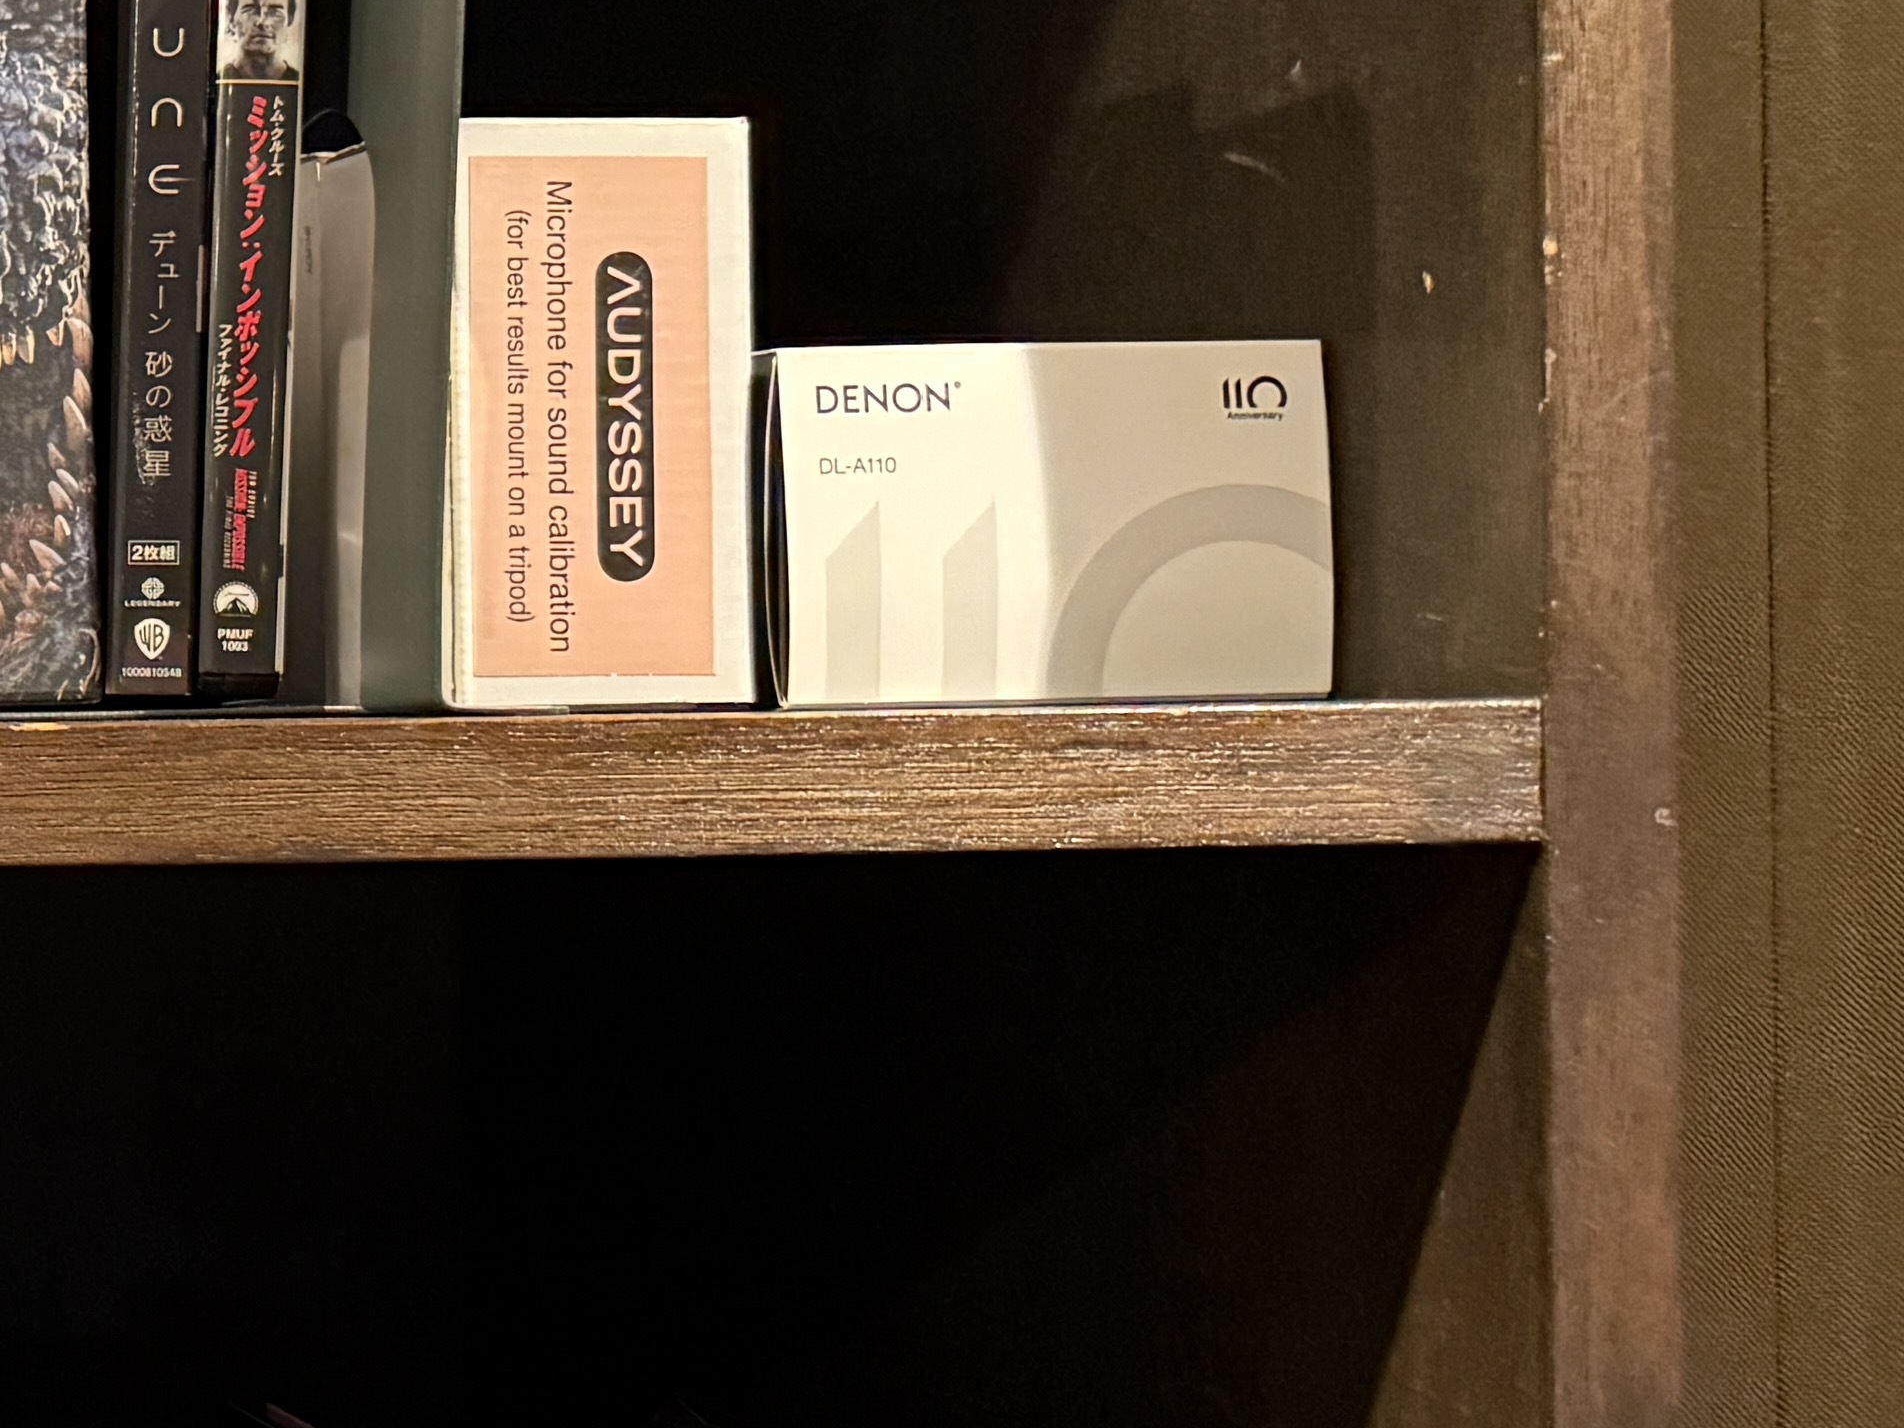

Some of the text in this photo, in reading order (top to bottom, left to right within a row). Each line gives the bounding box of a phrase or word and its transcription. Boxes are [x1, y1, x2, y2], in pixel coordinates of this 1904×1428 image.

[503, 208, 531, 242] (for
[505, 245, 531, 306] best
[142, 230, 181, 479] デューン 砂の惑星
[505, 315, 532, 397] results
[541, 179, 578, 654] Microphone for sound calibration
[604, 264, 645, 569] AUDYSSEY
[813, 382, 954, 415] DENON
[506, 402, 532, 480] mount
[817, 456, 898, 476] DL-A110
[507, 485, 531, 517] on
[506, 542, 537, 625] tripod)
